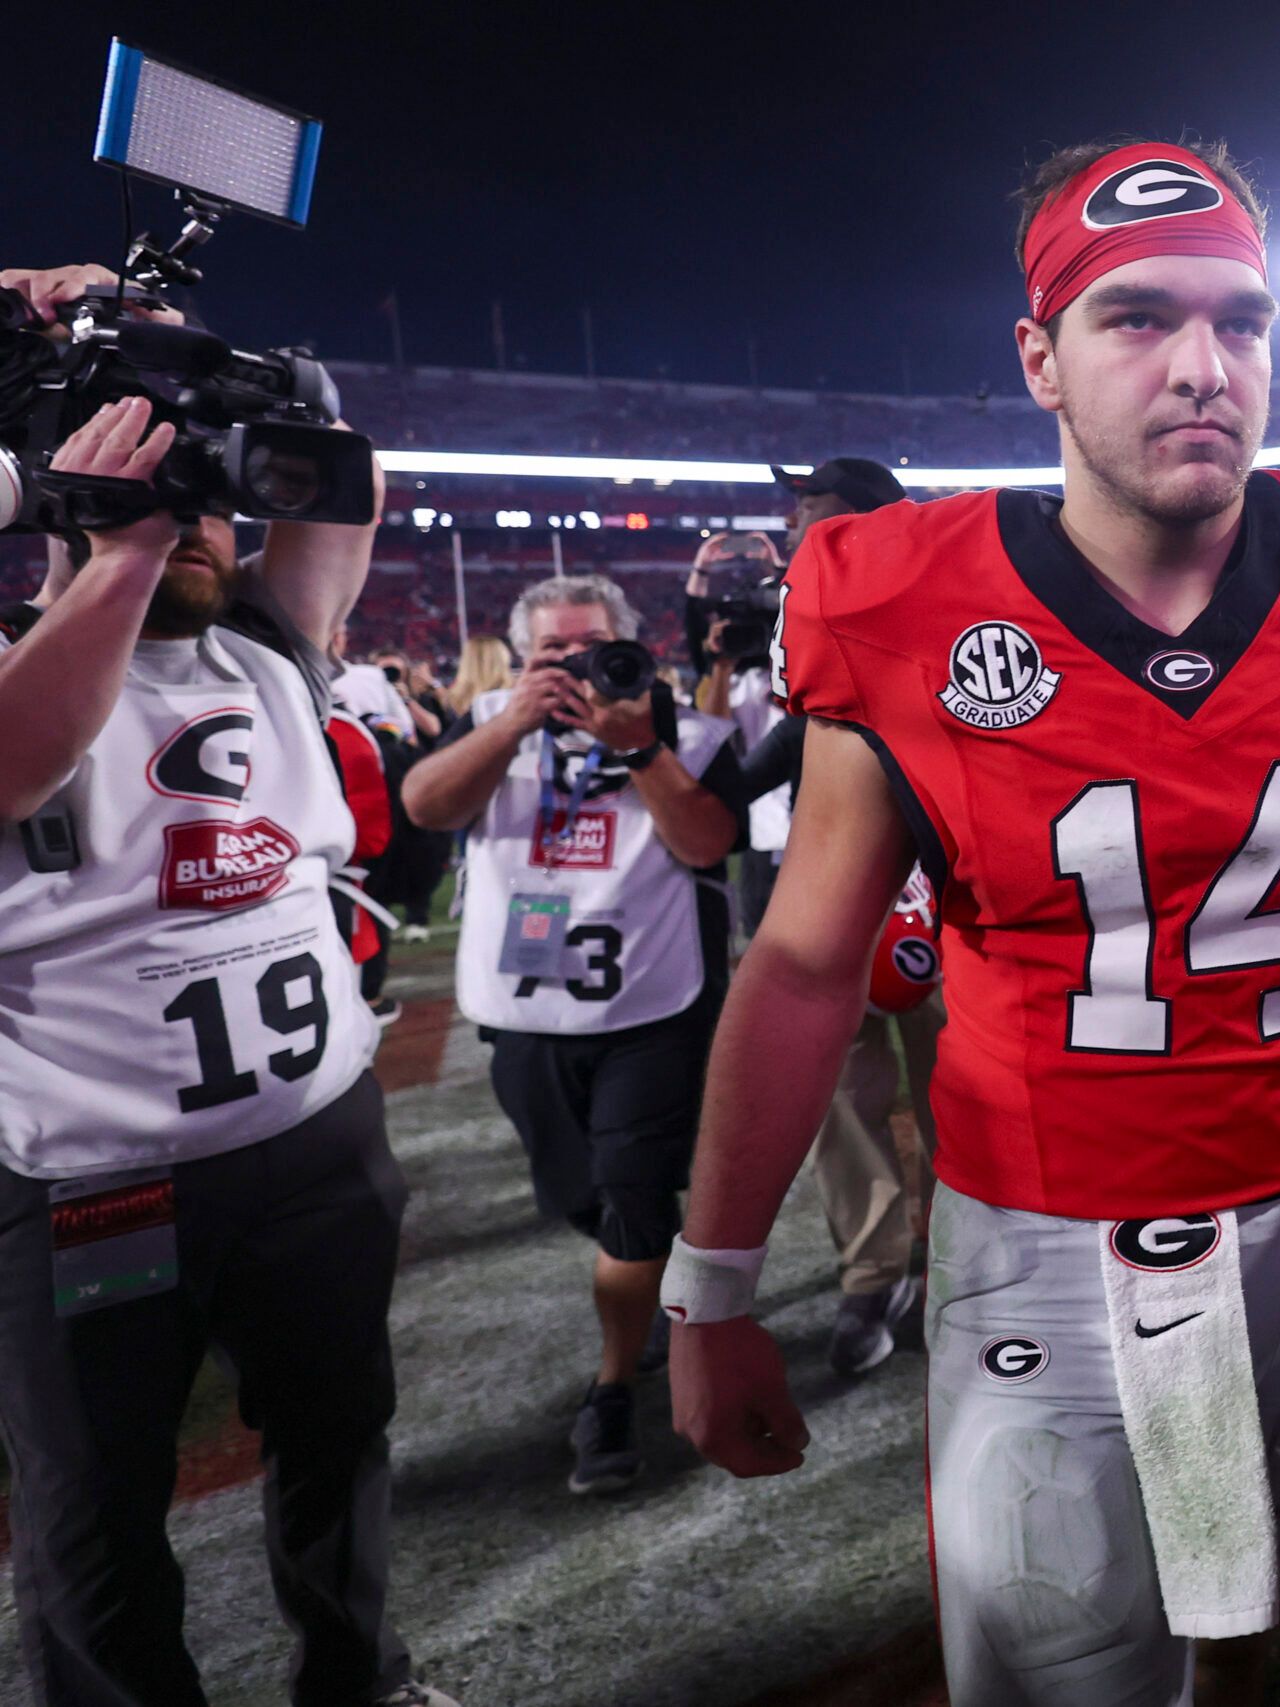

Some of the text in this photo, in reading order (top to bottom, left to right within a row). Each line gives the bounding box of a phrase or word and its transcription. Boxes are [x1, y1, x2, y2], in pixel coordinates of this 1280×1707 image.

[1083, 159, 1223, 231] G
[956, 626, 1034, 701] SEC
[1146, 651, 1215, 692] G
[953, 688, 1049, 728] GRADUATE
[176, 841, 292, 883] BUREAU
[162, 951, 330, 1113] 19
[1109, 1211, 1222, 1273] G
[981, 1334, 1049, 1383] G
